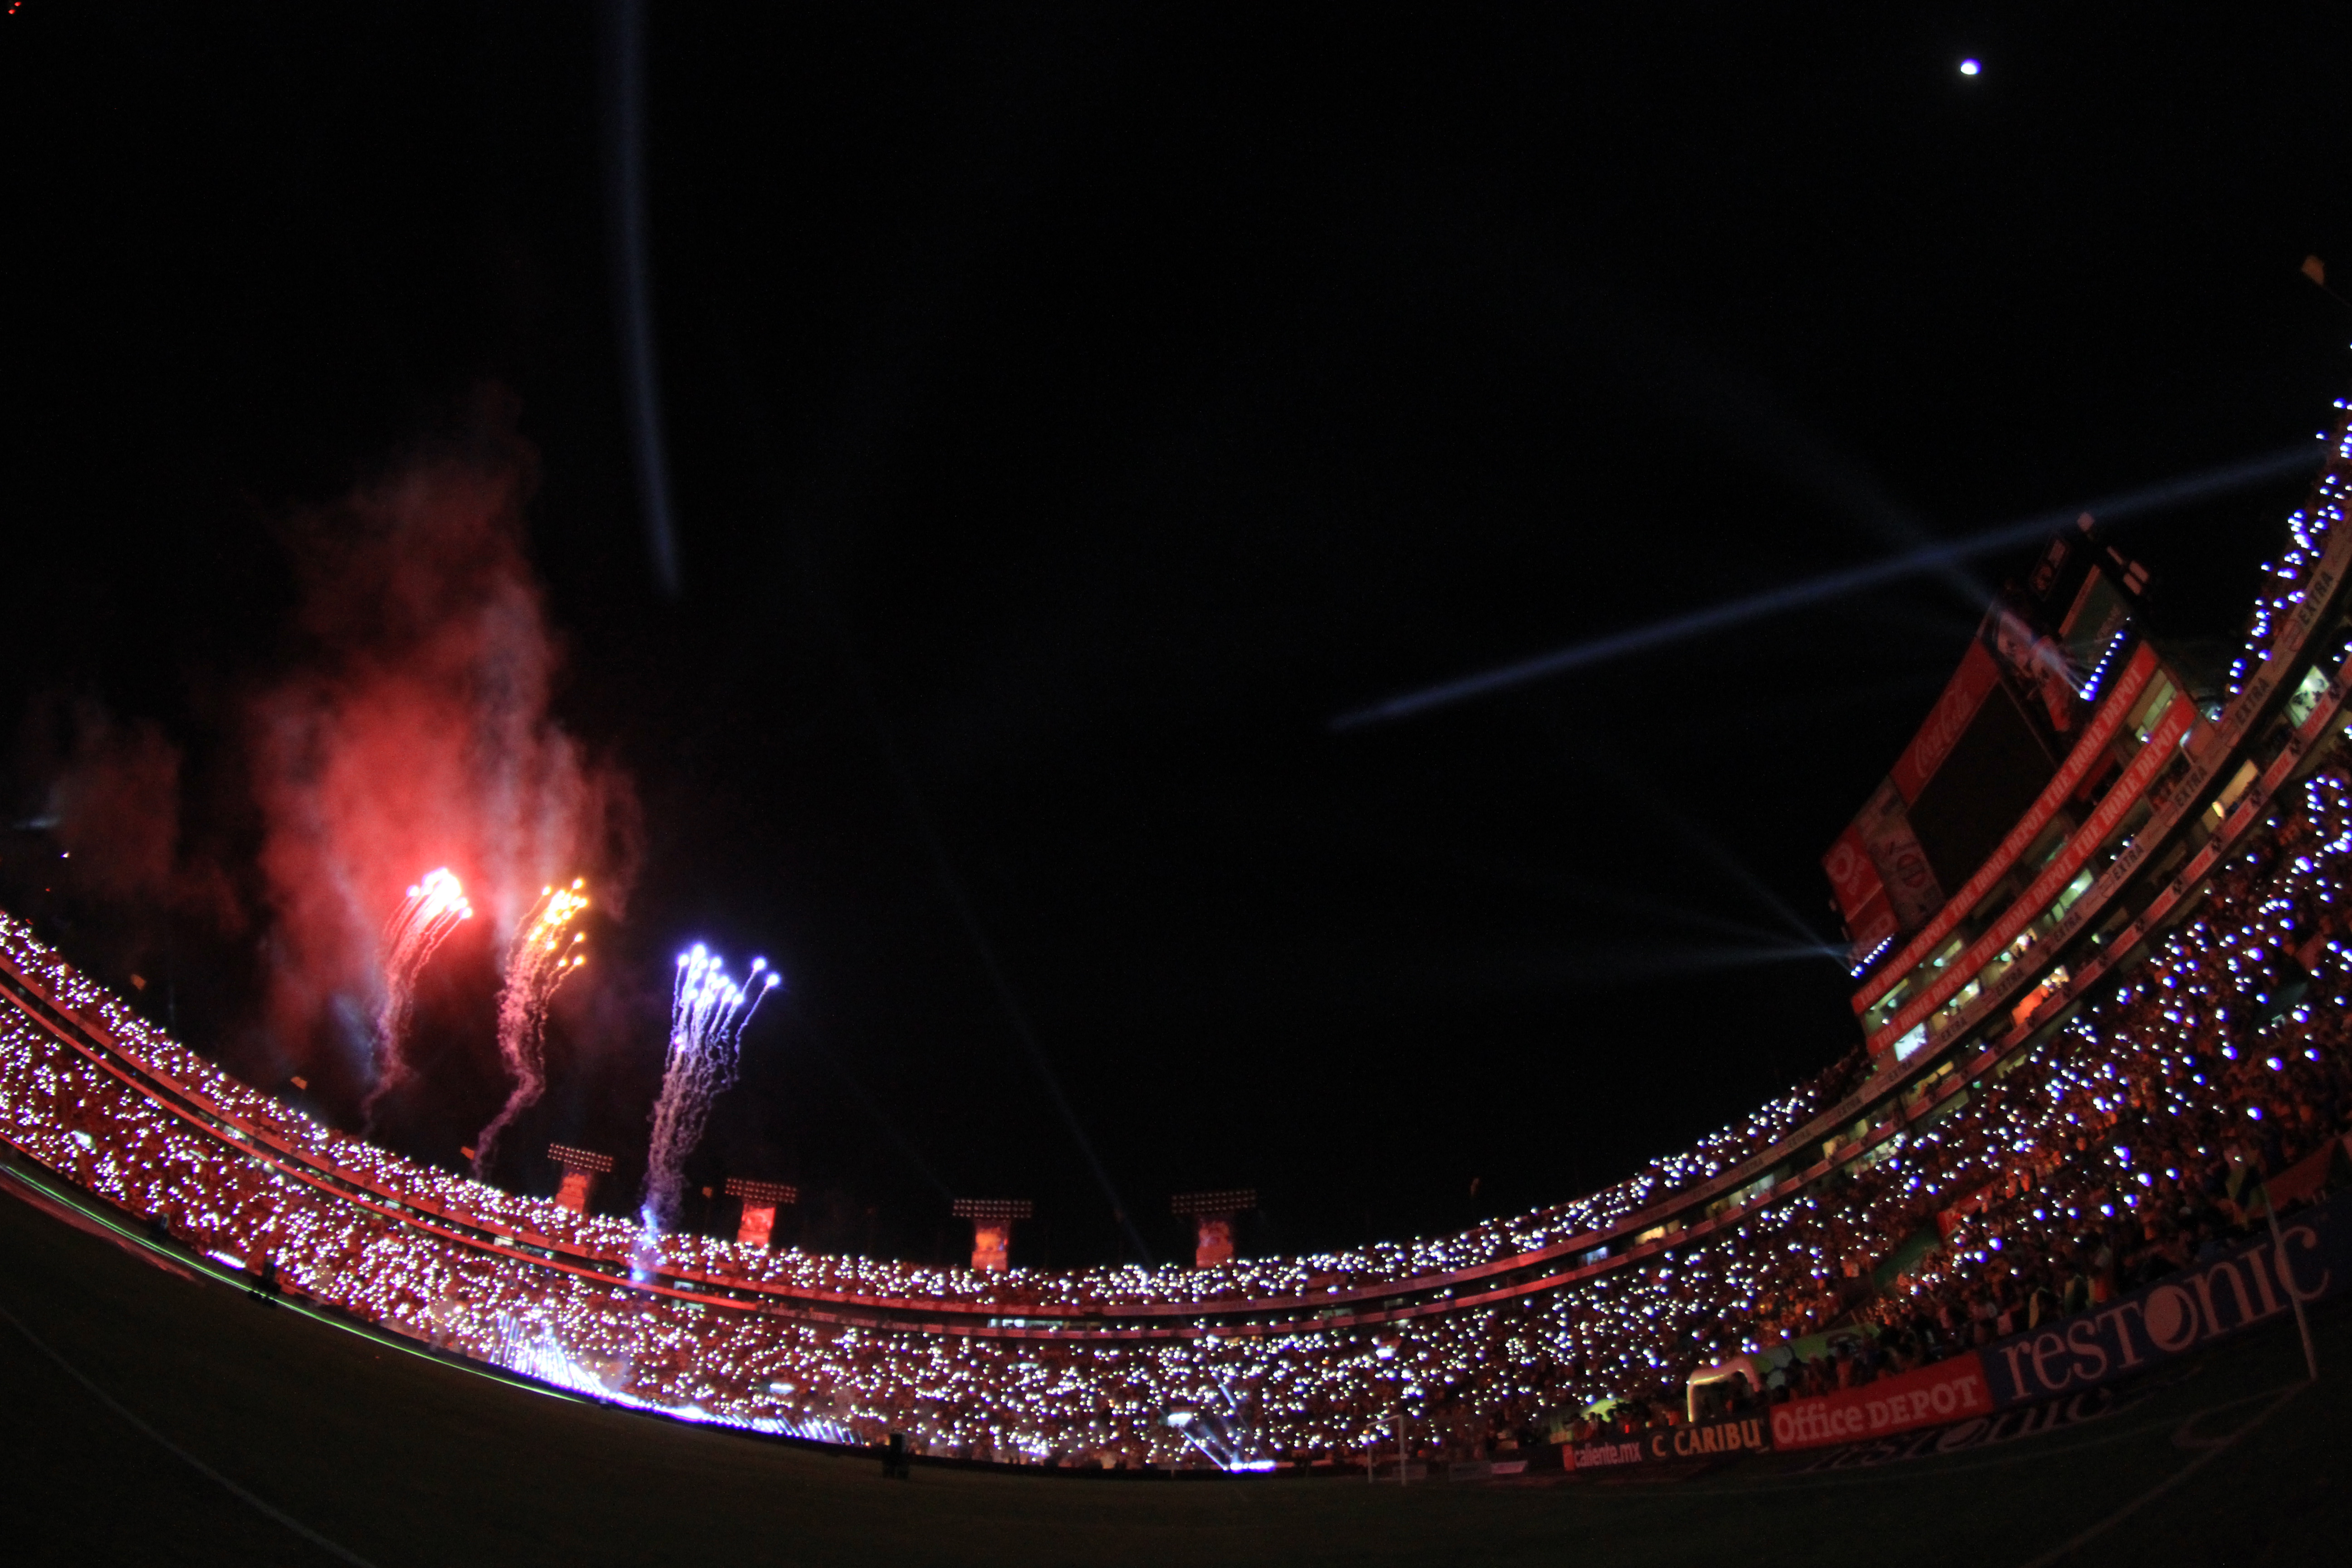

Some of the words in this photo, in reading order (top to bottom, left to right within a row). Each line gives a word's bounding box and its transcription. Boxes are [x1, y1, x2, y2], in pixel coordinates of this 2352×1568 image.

[2300, 573, 2333, 624] EXTRA
[2236, 678, 2269, 723] EXTRA
[2040, 768, 2075, 808] THE
[2063, 722, 2108, 774] HOME
[2095, 662, 2150, 727] DEPOT
[2070, 818, 2106, 858] THE
[2094, 771, 2143, 826] HOME
[2130, 714, 2186, 778] DEPOT
[2176, 765, 2207, 806] EXTRA
[2113, 844, 2144, 880] EXTRA
[2054, 911, 2083, 941] EXTRA
[1996, 969, 2023, 995] EXTRA
[1773, 1404, 1863, 1444] Office
[1864, 1376, 1978, 1429] DEPOT
[1575, 1442, 1642, 1468] caliente.mx
[1675, 1420, 1763, 1456] CARIBU
